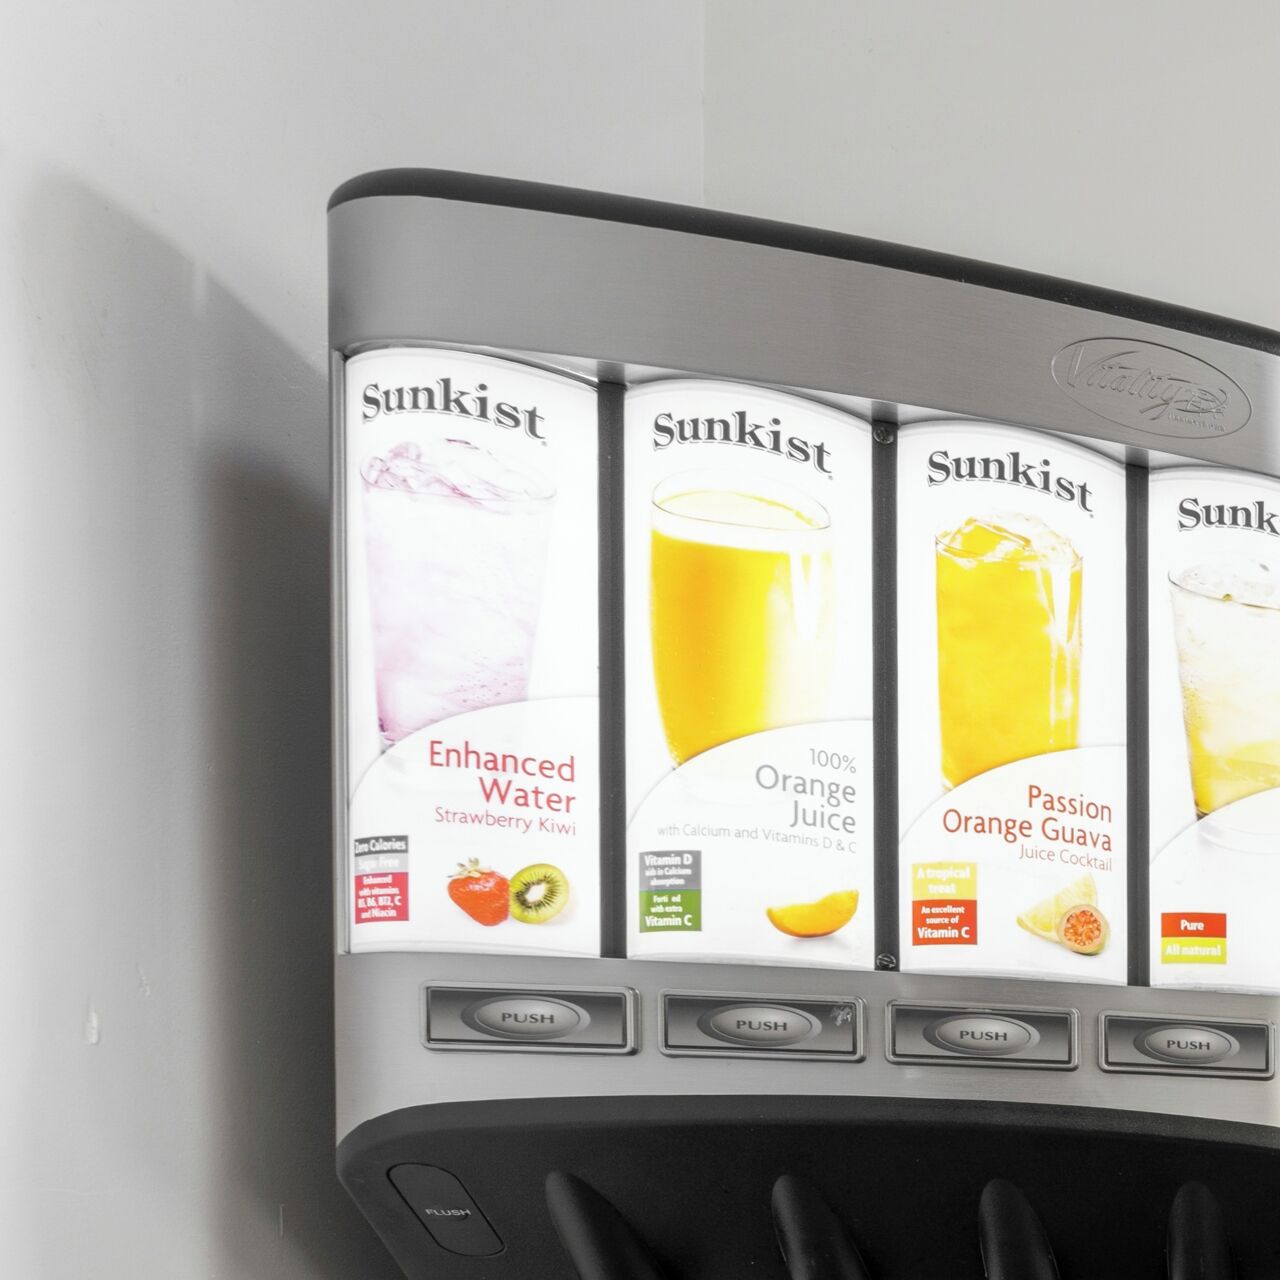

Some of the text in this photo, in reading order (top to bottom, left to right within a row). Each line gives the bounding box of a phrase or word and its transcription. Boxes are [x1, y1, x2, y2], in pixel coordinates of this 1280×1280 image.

[362, 378, 547, 439] Sunkist
[653, 410, 832, 475] Sunkist
[927, 450, 1093, 513] Sunkist
[430, 740, 575, 783] Enhanced
[809, 748, 856, 774] 100%
[755, 764, 856, 808] Orange
[479, 776, 576, 813] Water
[1028, 784, 1112, 823] Passion
[434, 806, 576, 836] Strawberry Kiwi
[789, 800, 856, 834] Juice
[657, 824, 680, 836] with
[682, 823, 731, 838] Calcium
[734, 827, 758, 840] and
[762, 829, 819, 847] Vitamins
[822, 837, 832, 849] D
[836, 840, 845, 851] &
[943, 808, 1112, 852] Orange Guava
[369, 838, 406, 851] Calories
[644, 853, 693, 867] Vitamin D
[1019, 844, 1112, 872] Juice Cocktail
[918, 866, 970, 881] A tropical
[921, 905, 965, 914] An excellent
[645, 914, 693, 927] Vitamin C
[950, 915, 960, 924] of
[1180, 919, 1205, 931] Pure
[917, 926, 971, 939] Vitamin C
[1166, 943, 1221, 956] All natural
[501, 1010, 555, 1025] PUSH
[735, 1018, 788, 1032] PUSH
[959, 1029, 1008, 1042] PUSH
[1166, 1038, 1211, 1051] PUSH
[425, 1208, 472, 1217] FLUSH
